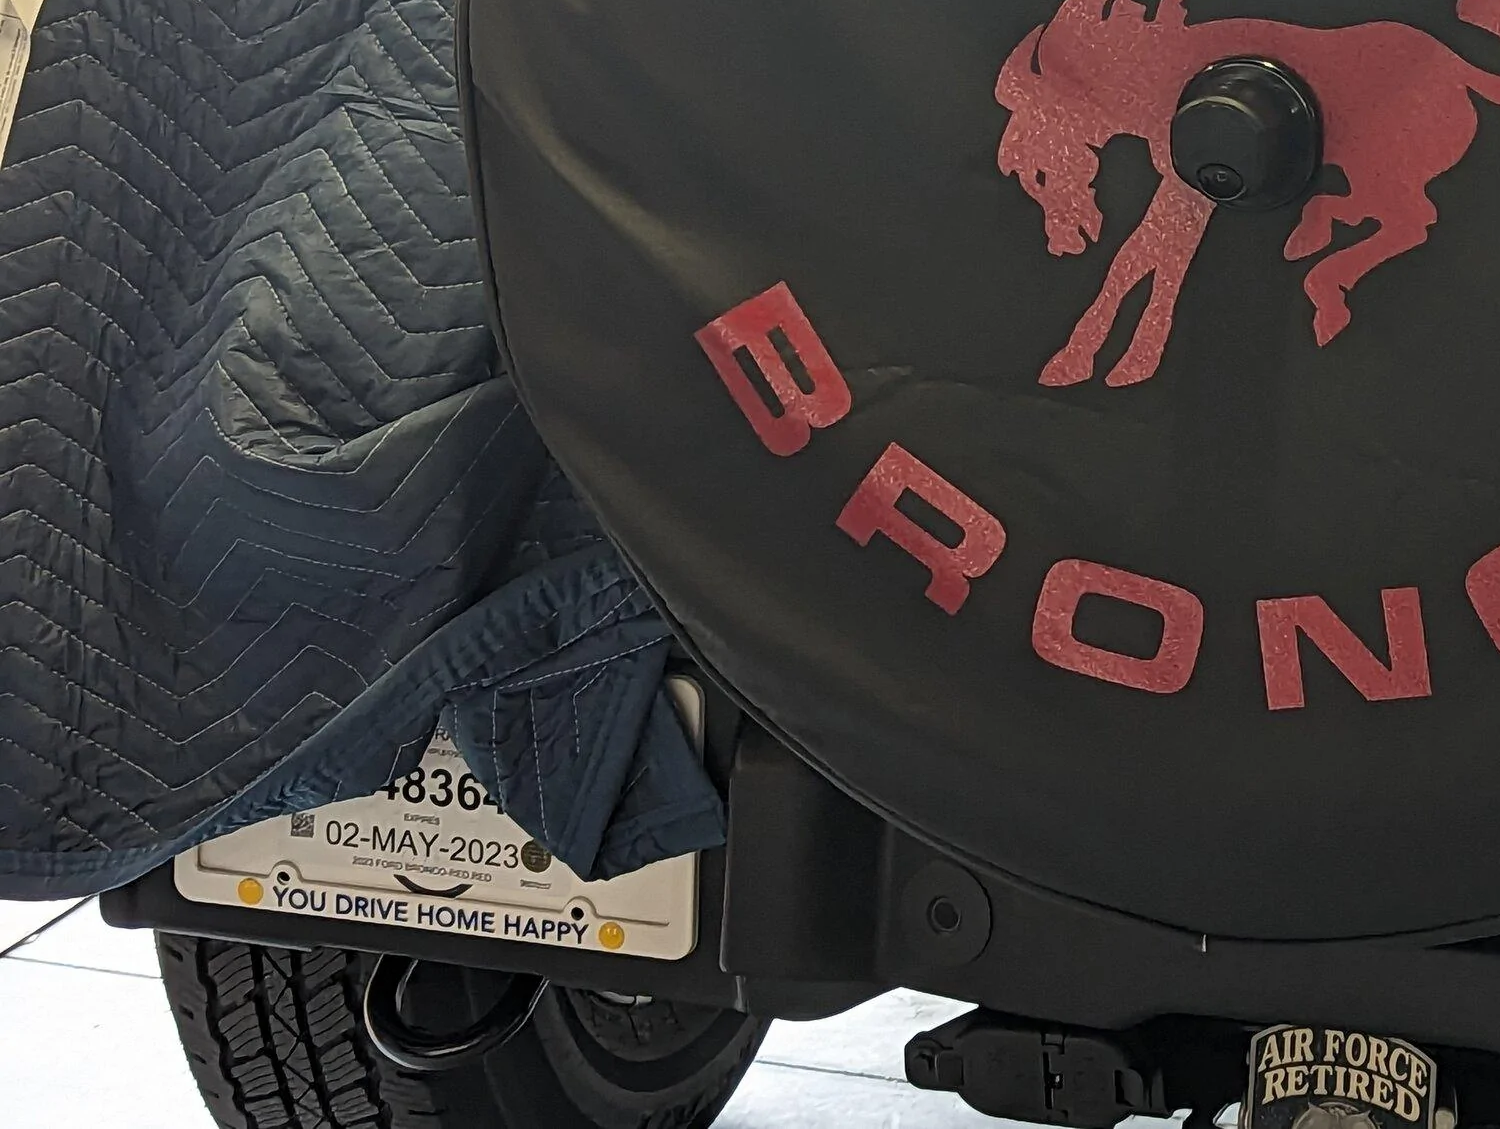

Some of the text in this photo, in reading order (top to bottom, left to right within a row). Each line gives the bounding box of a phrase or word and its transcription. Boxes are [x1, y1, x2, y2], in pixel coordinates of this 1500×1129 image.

[325, 819, 519, 869] 02-MAY-2023
[272, 885, 590, 945] YOU DRIVE HOME HAPPY
[1257, 1027, 1428, 1099] AIR FORCE
[1261, 1064, 1421, 1123] RETIRED
